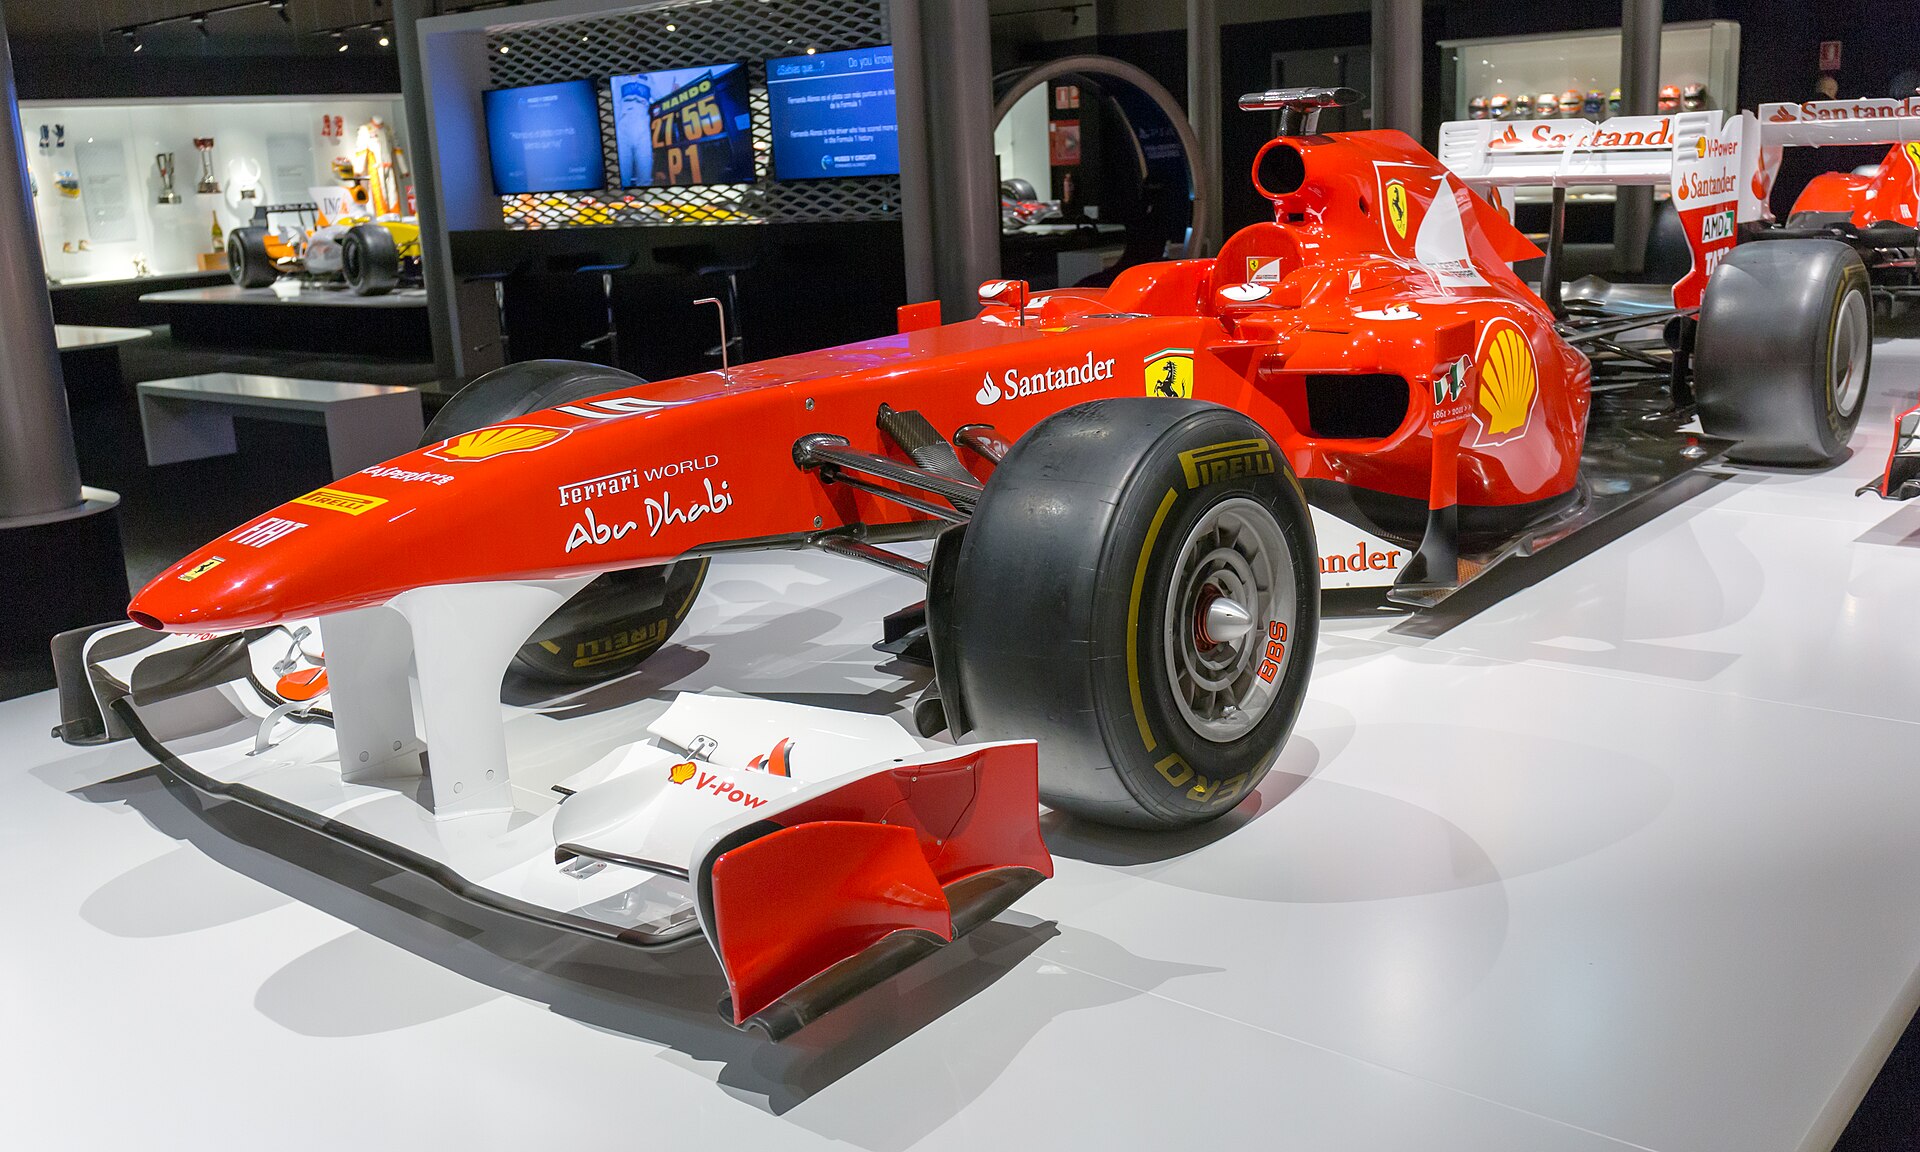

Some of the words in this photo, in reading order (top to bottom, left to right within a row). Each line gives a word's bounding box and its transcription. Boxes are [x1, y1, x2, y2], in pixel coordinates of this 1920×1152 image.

[848, 57, 858, 68] Do
[860, 57, 872, 69] you
[1706, 139, 1738, 158] V-Power
[1691, 166, 1737, 199] Santander
[1702, 214, 1725, 242] AMD
[1004, 350, 1116, 401] Santander
[558, 468, 640, 507] Ferrari
[643, 454, 719, 482] WORLD
[1177, 438, 1275, 490] PIRELLI
[302, 492, 374, 510] PIRELLI
[565, 507, 638, 554] Abu
[644, 477, 733, 538] Dhabi
[229, 517, 309, 548] FIAT
[1256, 620, 1288, 684] BBS
[696, 771, 768, 809] V-Pow
